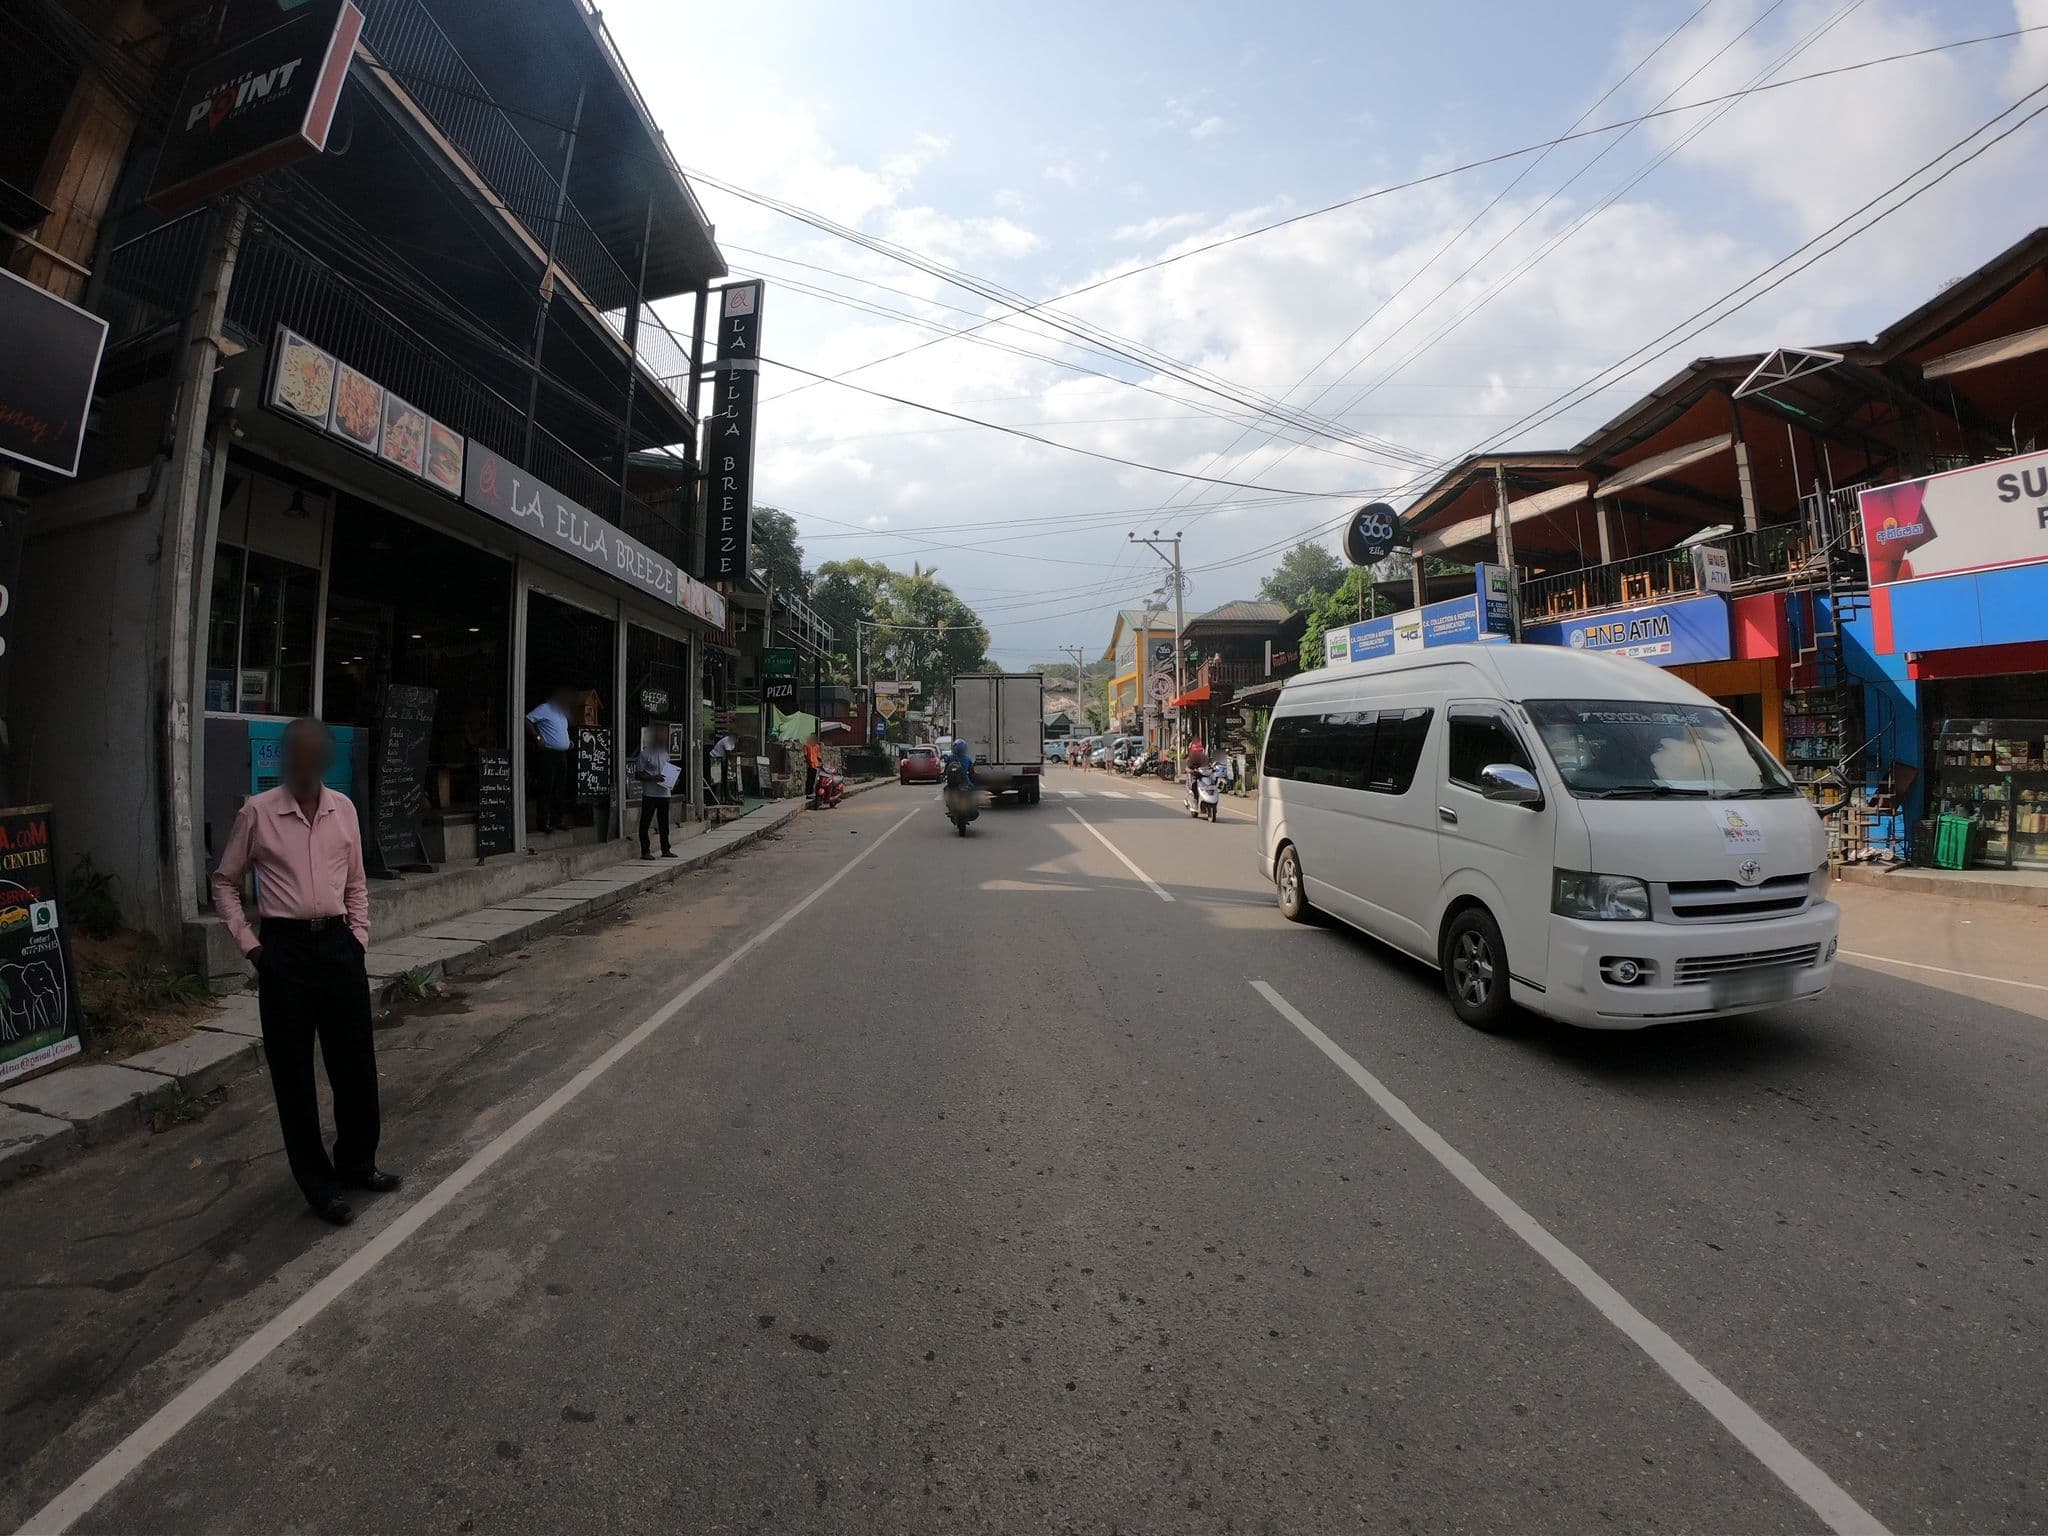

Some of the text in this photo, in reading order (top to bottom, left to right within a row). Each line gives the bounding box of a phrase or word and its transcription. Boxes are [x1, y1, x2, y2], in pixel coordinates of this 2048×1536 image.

[719, 456, 738, 573] BREEZE
[510, 479, 674, 595] LA ELLA BREEZE
[1369, 546, 1385, 556] Ella
[1711, 571, 1729, 585] ATM
[1585, 615, 1670, 647] HNB ATM
[1643, 646, 1656, 654] VISA
[767, 684, 793, 698] PIZZA
[3, 848, 48, 870] CENTRE
